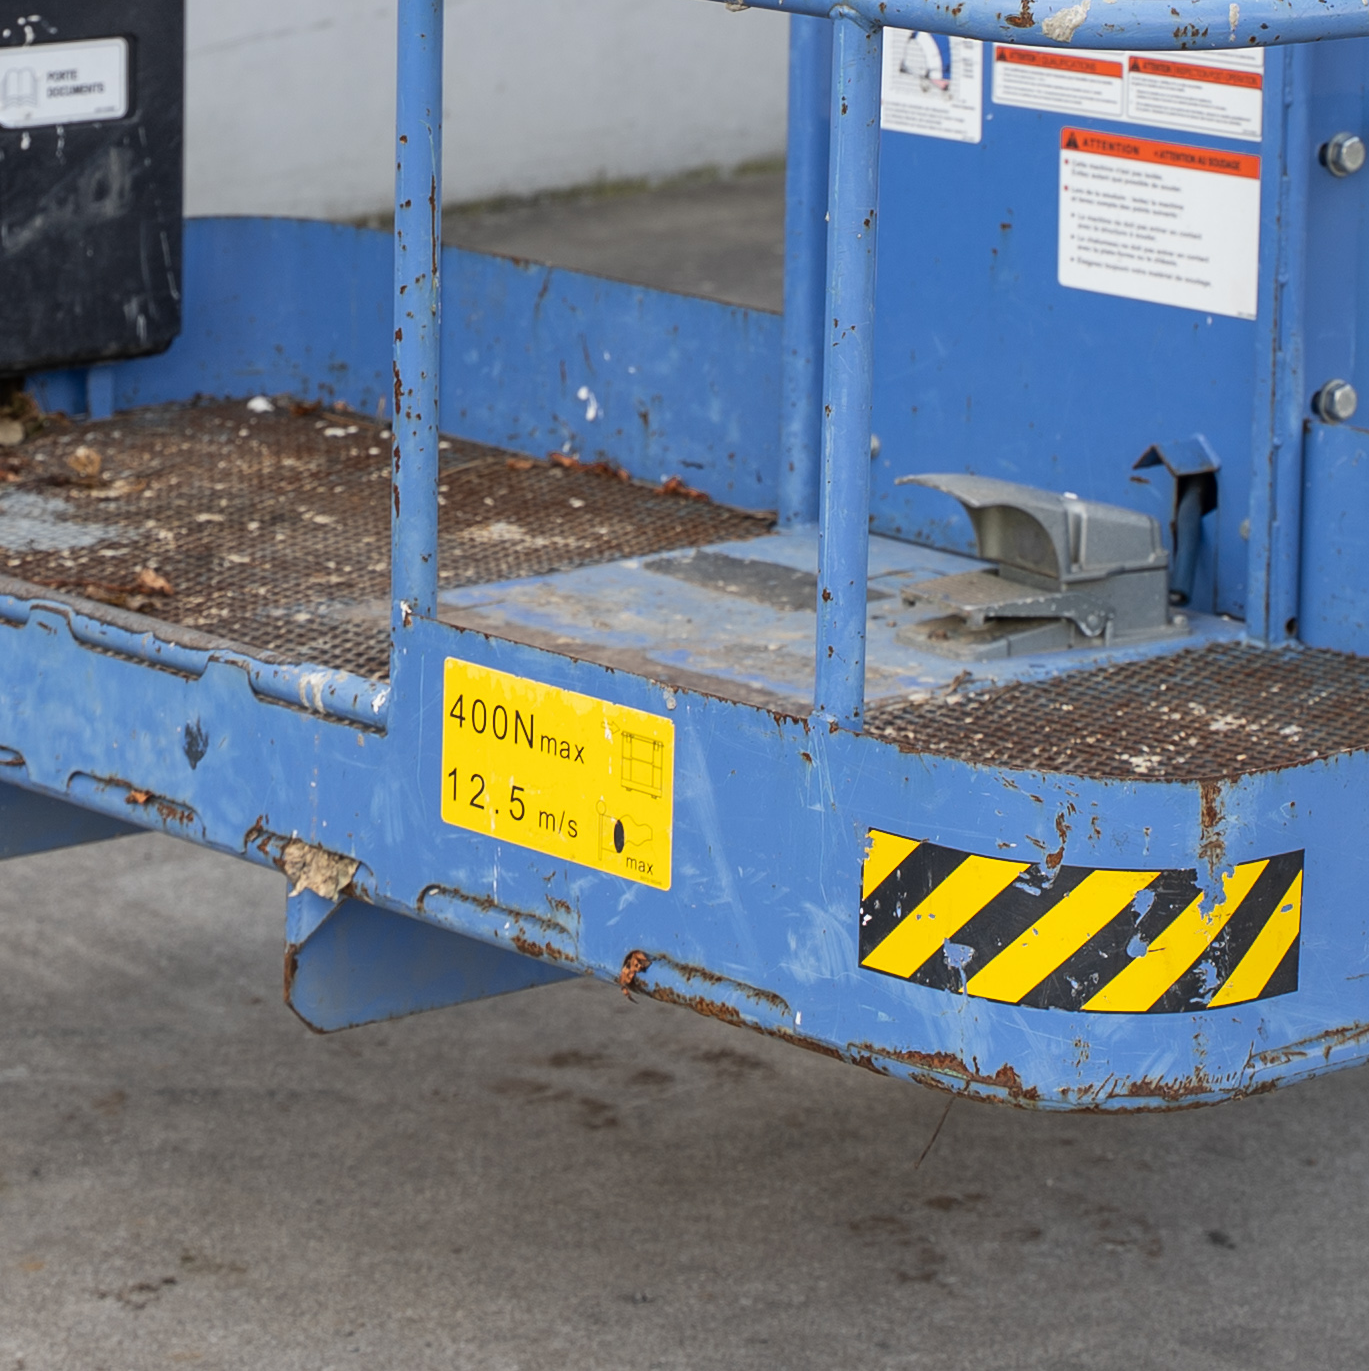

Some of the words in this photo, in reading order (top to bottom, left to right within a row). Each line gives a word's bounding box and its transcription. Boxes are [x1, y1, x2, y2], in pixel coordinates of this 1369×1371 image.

[47, 83, 104, 98] DOCUMENTS
[1082, 137, 1139, 155] ATTENTION
[448, 767, 525, 821] 12.5
[539, 810, 578, 838] m/s
[626, 856, 653, 875] max
